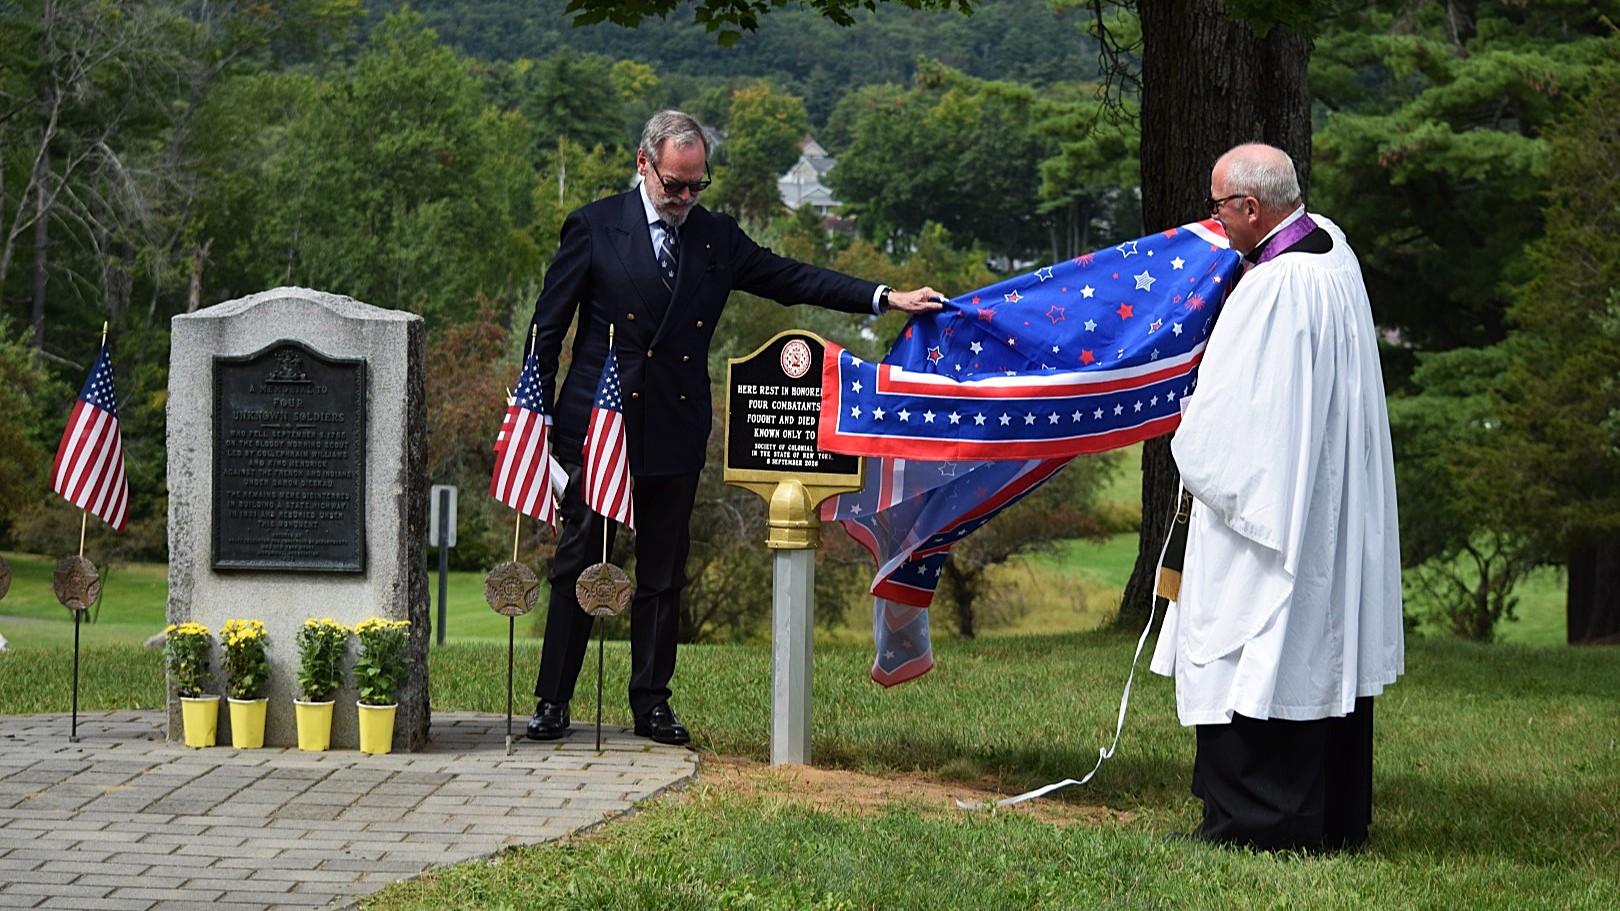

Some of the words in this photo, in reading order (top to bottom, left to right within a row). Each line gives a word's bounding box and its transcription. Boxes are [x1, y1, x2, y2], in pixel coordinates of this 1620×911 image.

[316, 385, 328, 393] TO
[738, 385, 757, 394] HERE
[760, 386, 779, 395] REST
[782, 387, 789, 396] IN
[792, 387, 822, 397] HONORE
[273, 397, 304, 408] FOUR
[749, 400, 768, 409] FOUR
[772, 401, 820, 411] COMBATANTS
[293, 411, 344, 421] SOLDIERS
[747, 414, 776, 424] FOUGHT
[779, 415, 794, 424] AND
[798, 416, 815, 425] DIED
[754, 428, 780, 438] KNOWN
[783, 430, 802, 439] ONLY
[805, 430, 815, 440] TO
